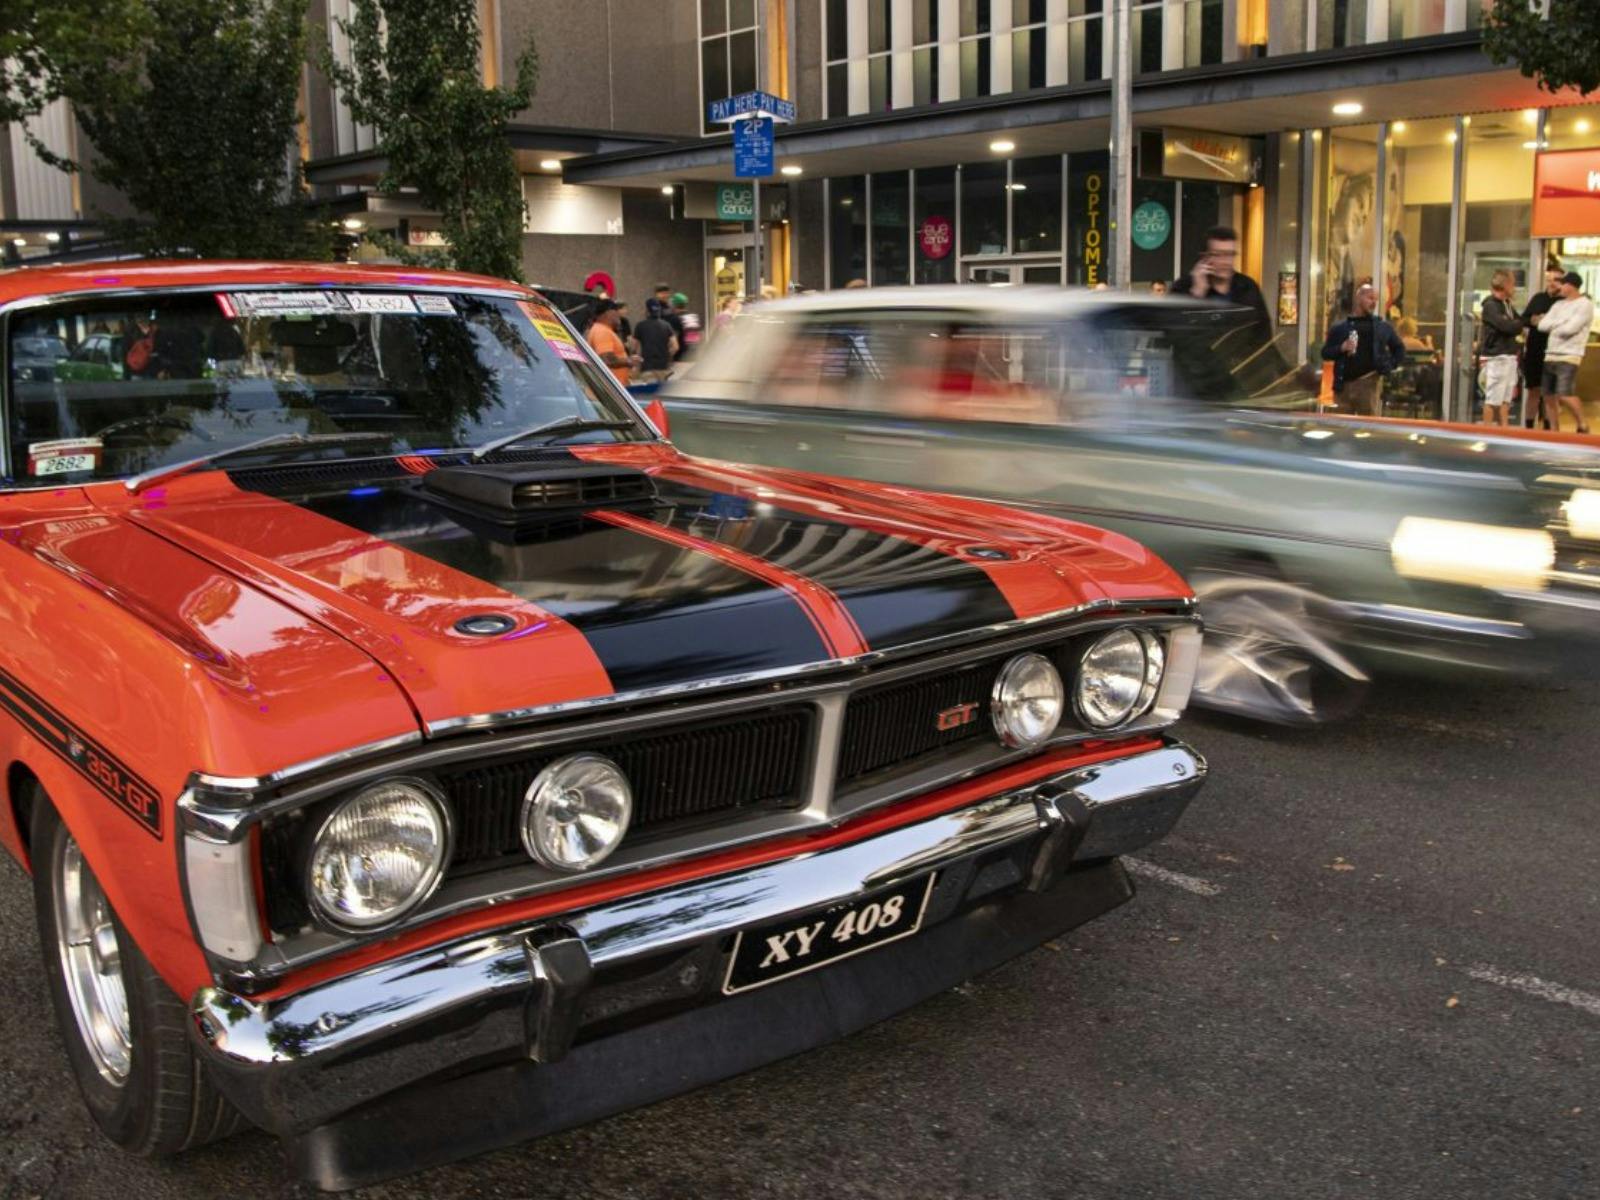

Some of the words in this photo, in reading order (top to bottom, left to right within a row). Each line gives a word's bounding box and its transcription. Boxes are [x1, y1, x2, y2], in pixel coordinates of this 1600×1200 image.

[712, 100, 730, 121] PAY
[735, 92, 759, 114] HERE
[761, 94, 774, 115] PAY
[743, 120, 763, 135] 2P
[722, 189, 752, 205] eye
[1086, 174, 1101, 289] OPTOME
[45, 456, 86, 472] 2682
[936, 702, 979, 731] GT
[759, 921, 826, 968] XY
[831, 895, 905, 943] 408
